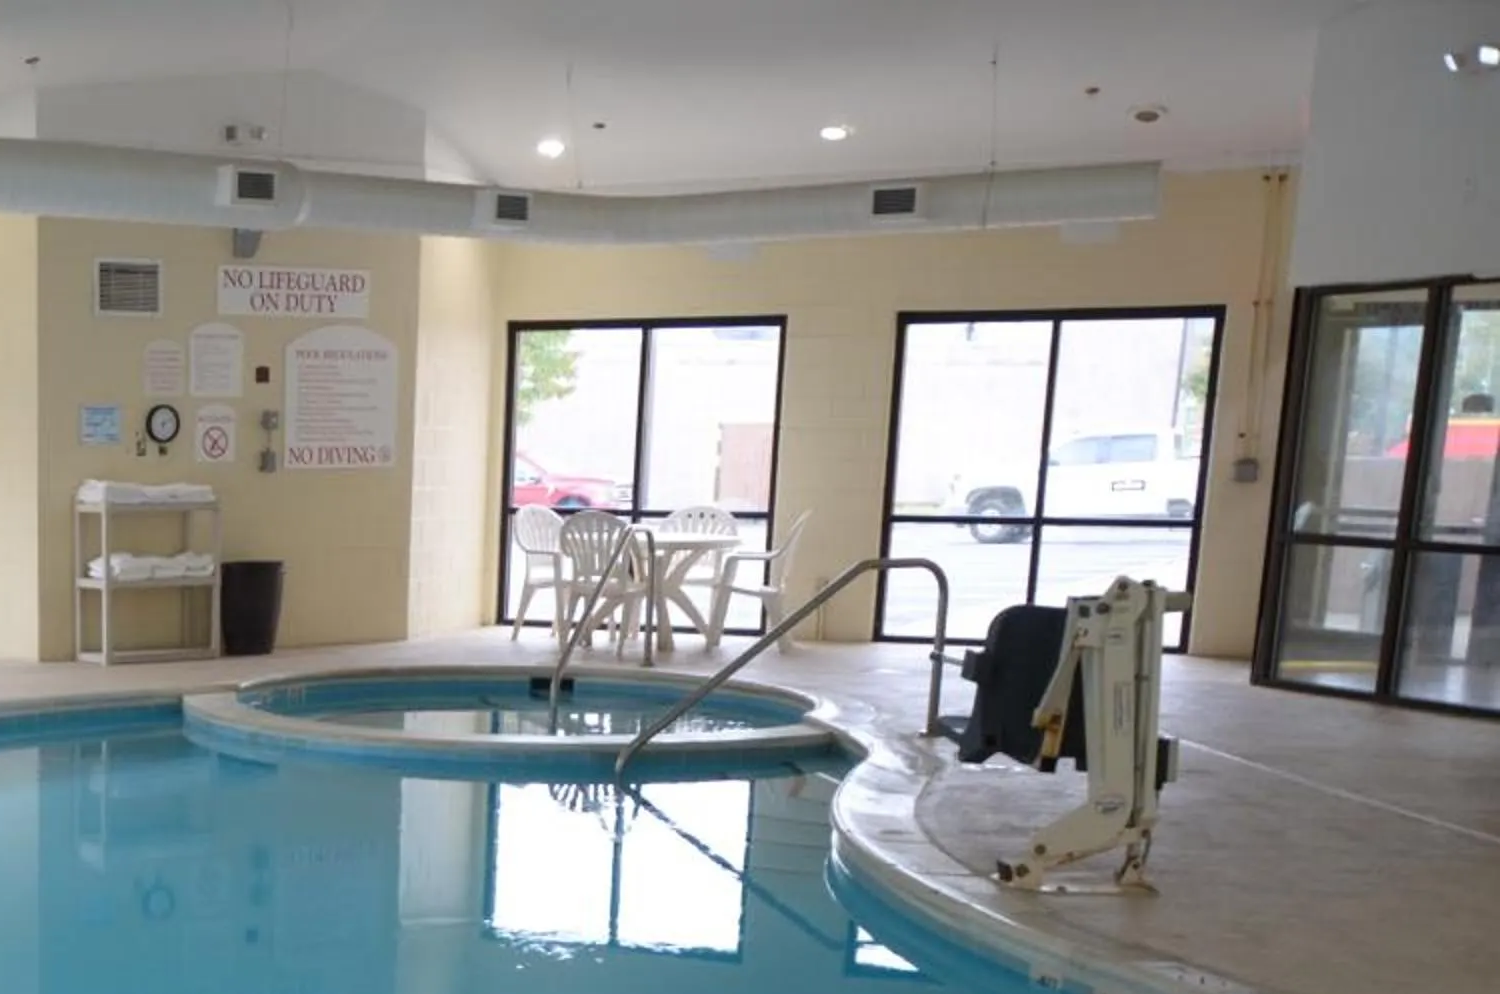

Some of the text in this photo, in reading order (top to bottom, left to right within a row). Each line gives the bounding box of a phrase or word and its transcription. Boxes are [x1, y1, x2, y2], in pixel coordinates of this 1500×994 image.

[223, 268, 366, 293] NO LIFEGUARD
[250, 292, 338, 314] ON DUTY
[288, 446, 376, 465] NO DIVING
